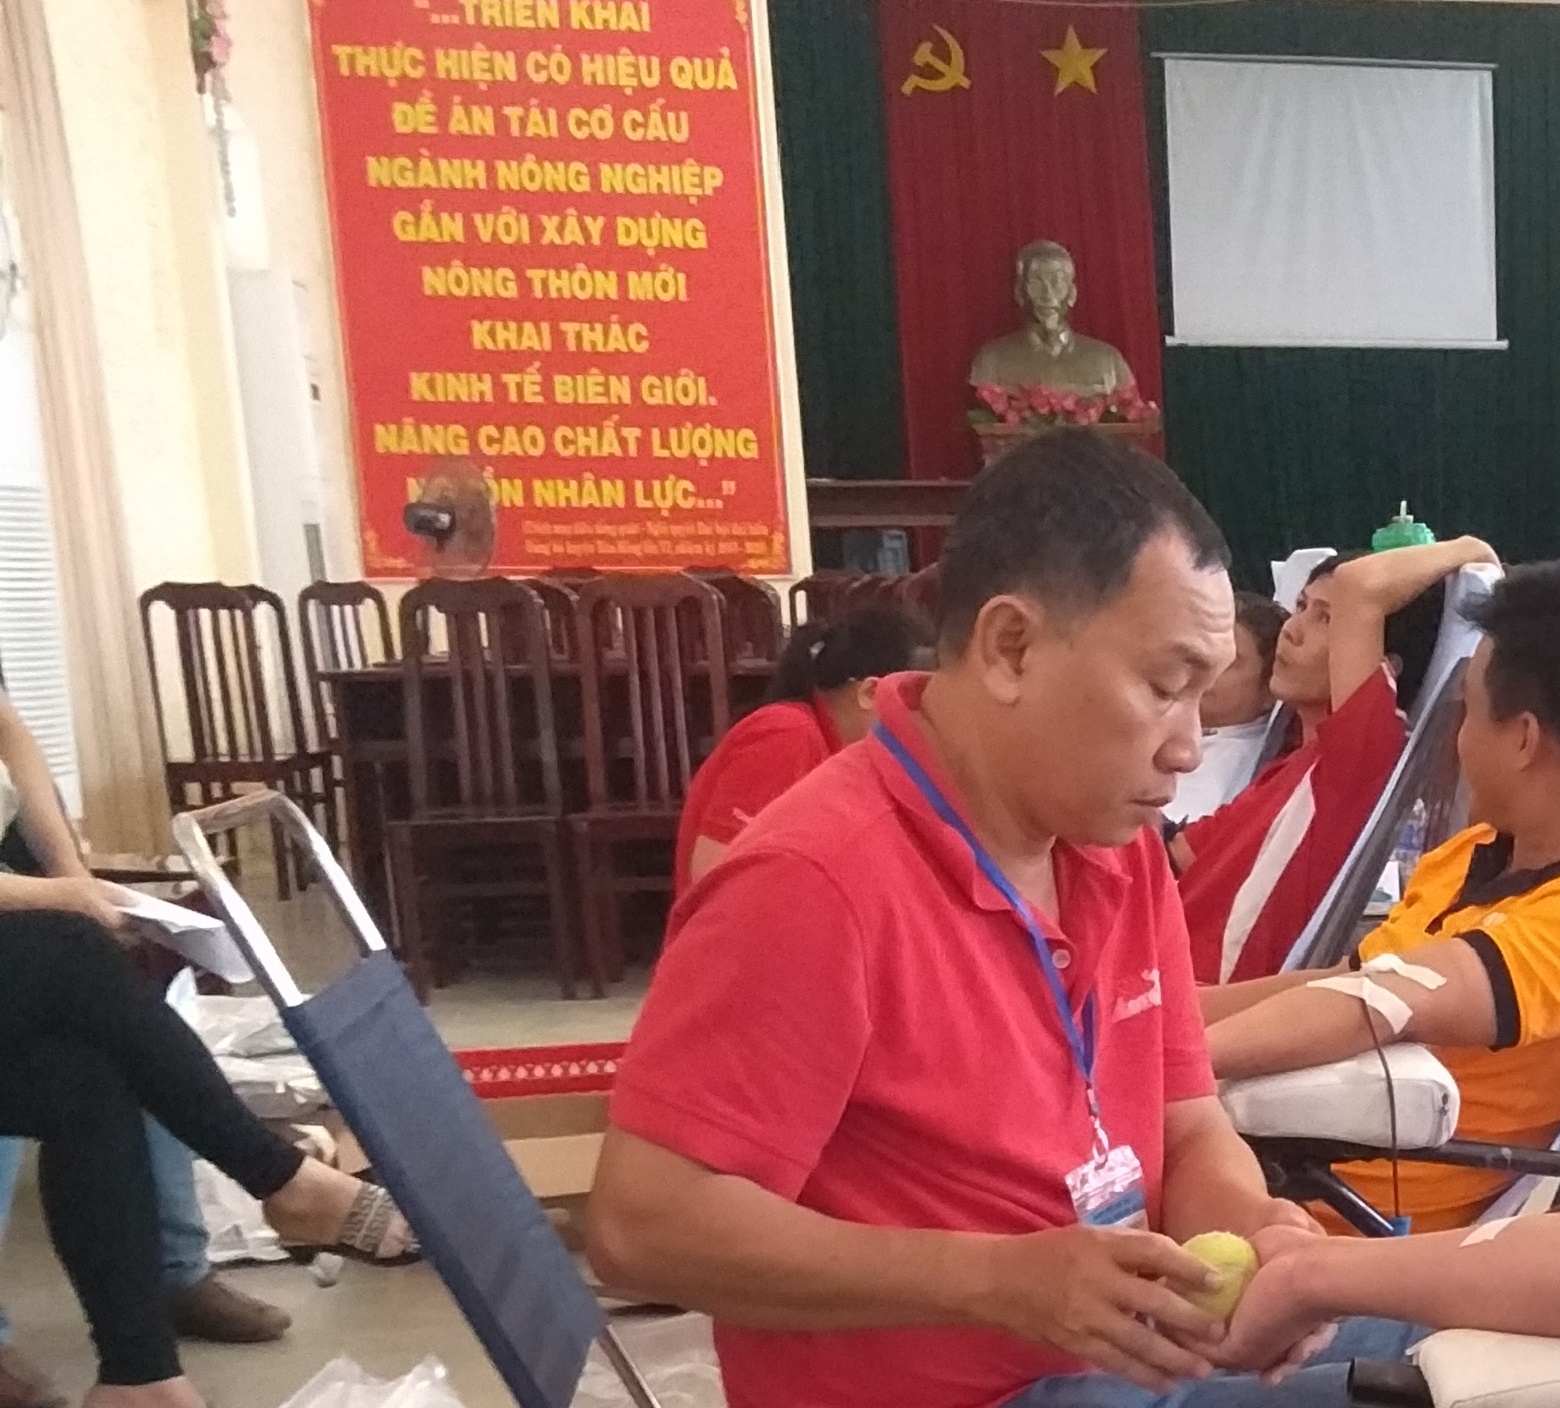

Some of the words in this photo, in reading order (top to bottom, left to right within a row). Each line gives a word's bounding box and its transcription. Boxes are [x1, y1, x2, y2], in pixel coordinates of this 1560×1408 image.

[570, 0, 650, 32] KHAI
[332, 41, 425, 87] THỰC
[436, 42, 516, 89] HIỆN
[526, 44, 571, 85] CÓ
[581, 47, 660, 94] HIỆU
[670, 47, 738, 90] QUẢ
[448, 97, 494, 136] ÁN
[503, 99, 558, 139] TÁI
[567, 104, 615, 139] CƠ
[623, 98, 689, 142] CẤU
[365, 150, 487, 189] NGÀNH
[495, 154, 590, 192] NÔNG
[600, 158, 724, 205] NGHIỆP
[474, 206, 530, 244] VỚI
[540, 208, 604, 246] XÂY
[617, 213, 708, 255] DỰNG
[422, 260, 518, 299] NÔNG
[527, 263, 617, 300] THÔN
[628, 263, 689, 302] MỚI
[471, 319, 551, 352] KHAI
[561, 315, 649, 354] THÁC
[409, 371, 493, 402] KINH
[501, 362, 544, 403] TẾ
[554, 368, 631, 404] BIÊN
[375, 418, 470, 455] NÂNG
[478, 425, 545, 456] CAO
[553, 415, 641, 457] CHẤT
[652, 422, 758, 466] LƯỢNG
[533, 473, 625, 508] NHÂN
